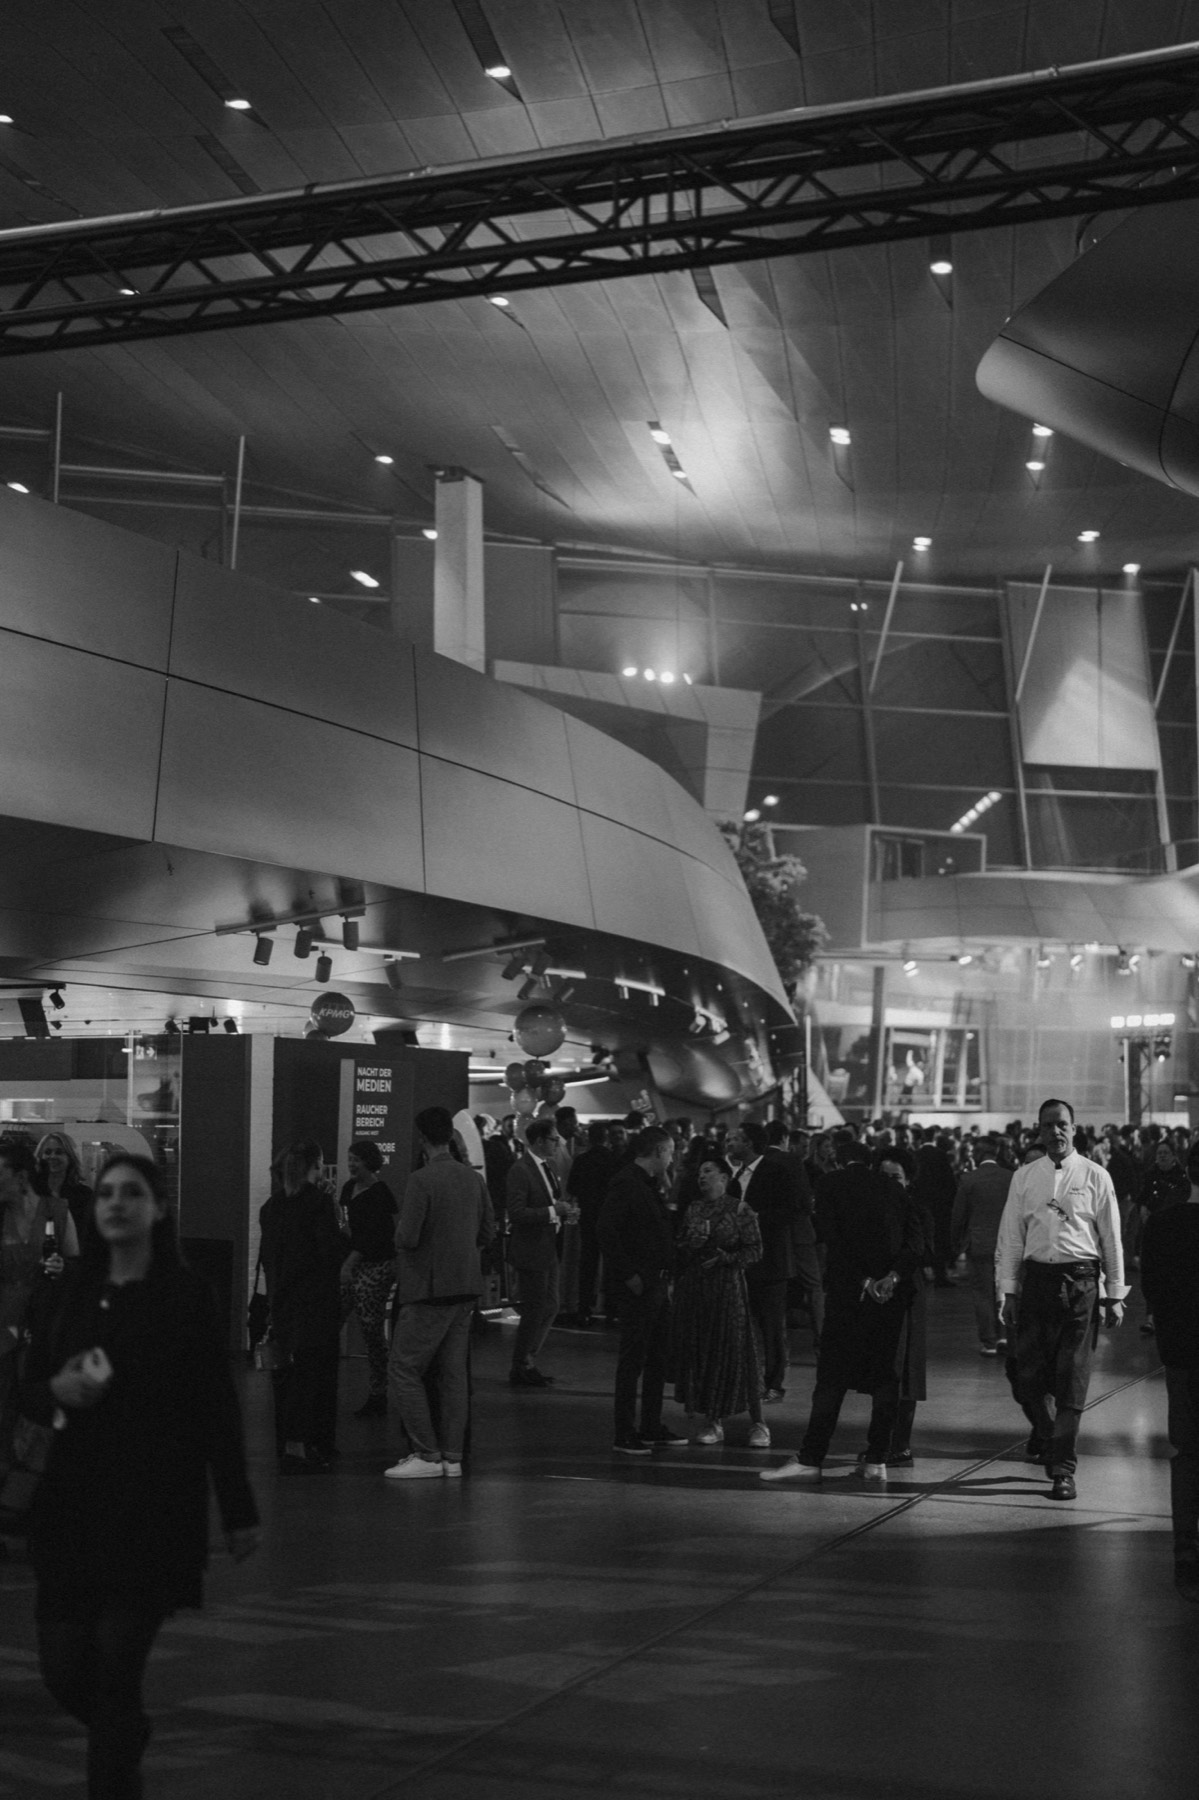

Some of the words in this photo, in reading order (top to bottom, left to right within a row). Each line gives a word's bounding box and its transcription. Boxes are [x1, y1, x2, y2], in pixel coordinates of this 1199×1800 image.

[319, 1008, 350, 1019] KPMG
[357, 1067, 378, 1077] NACHT
[379, 1068, 392, 1077] DER
[357, 1078, 392, 1093] MEDIEN
[356, 1104, 388, 1114] RAUCHER
[356, 1117, 385, 1127] BEREICH
